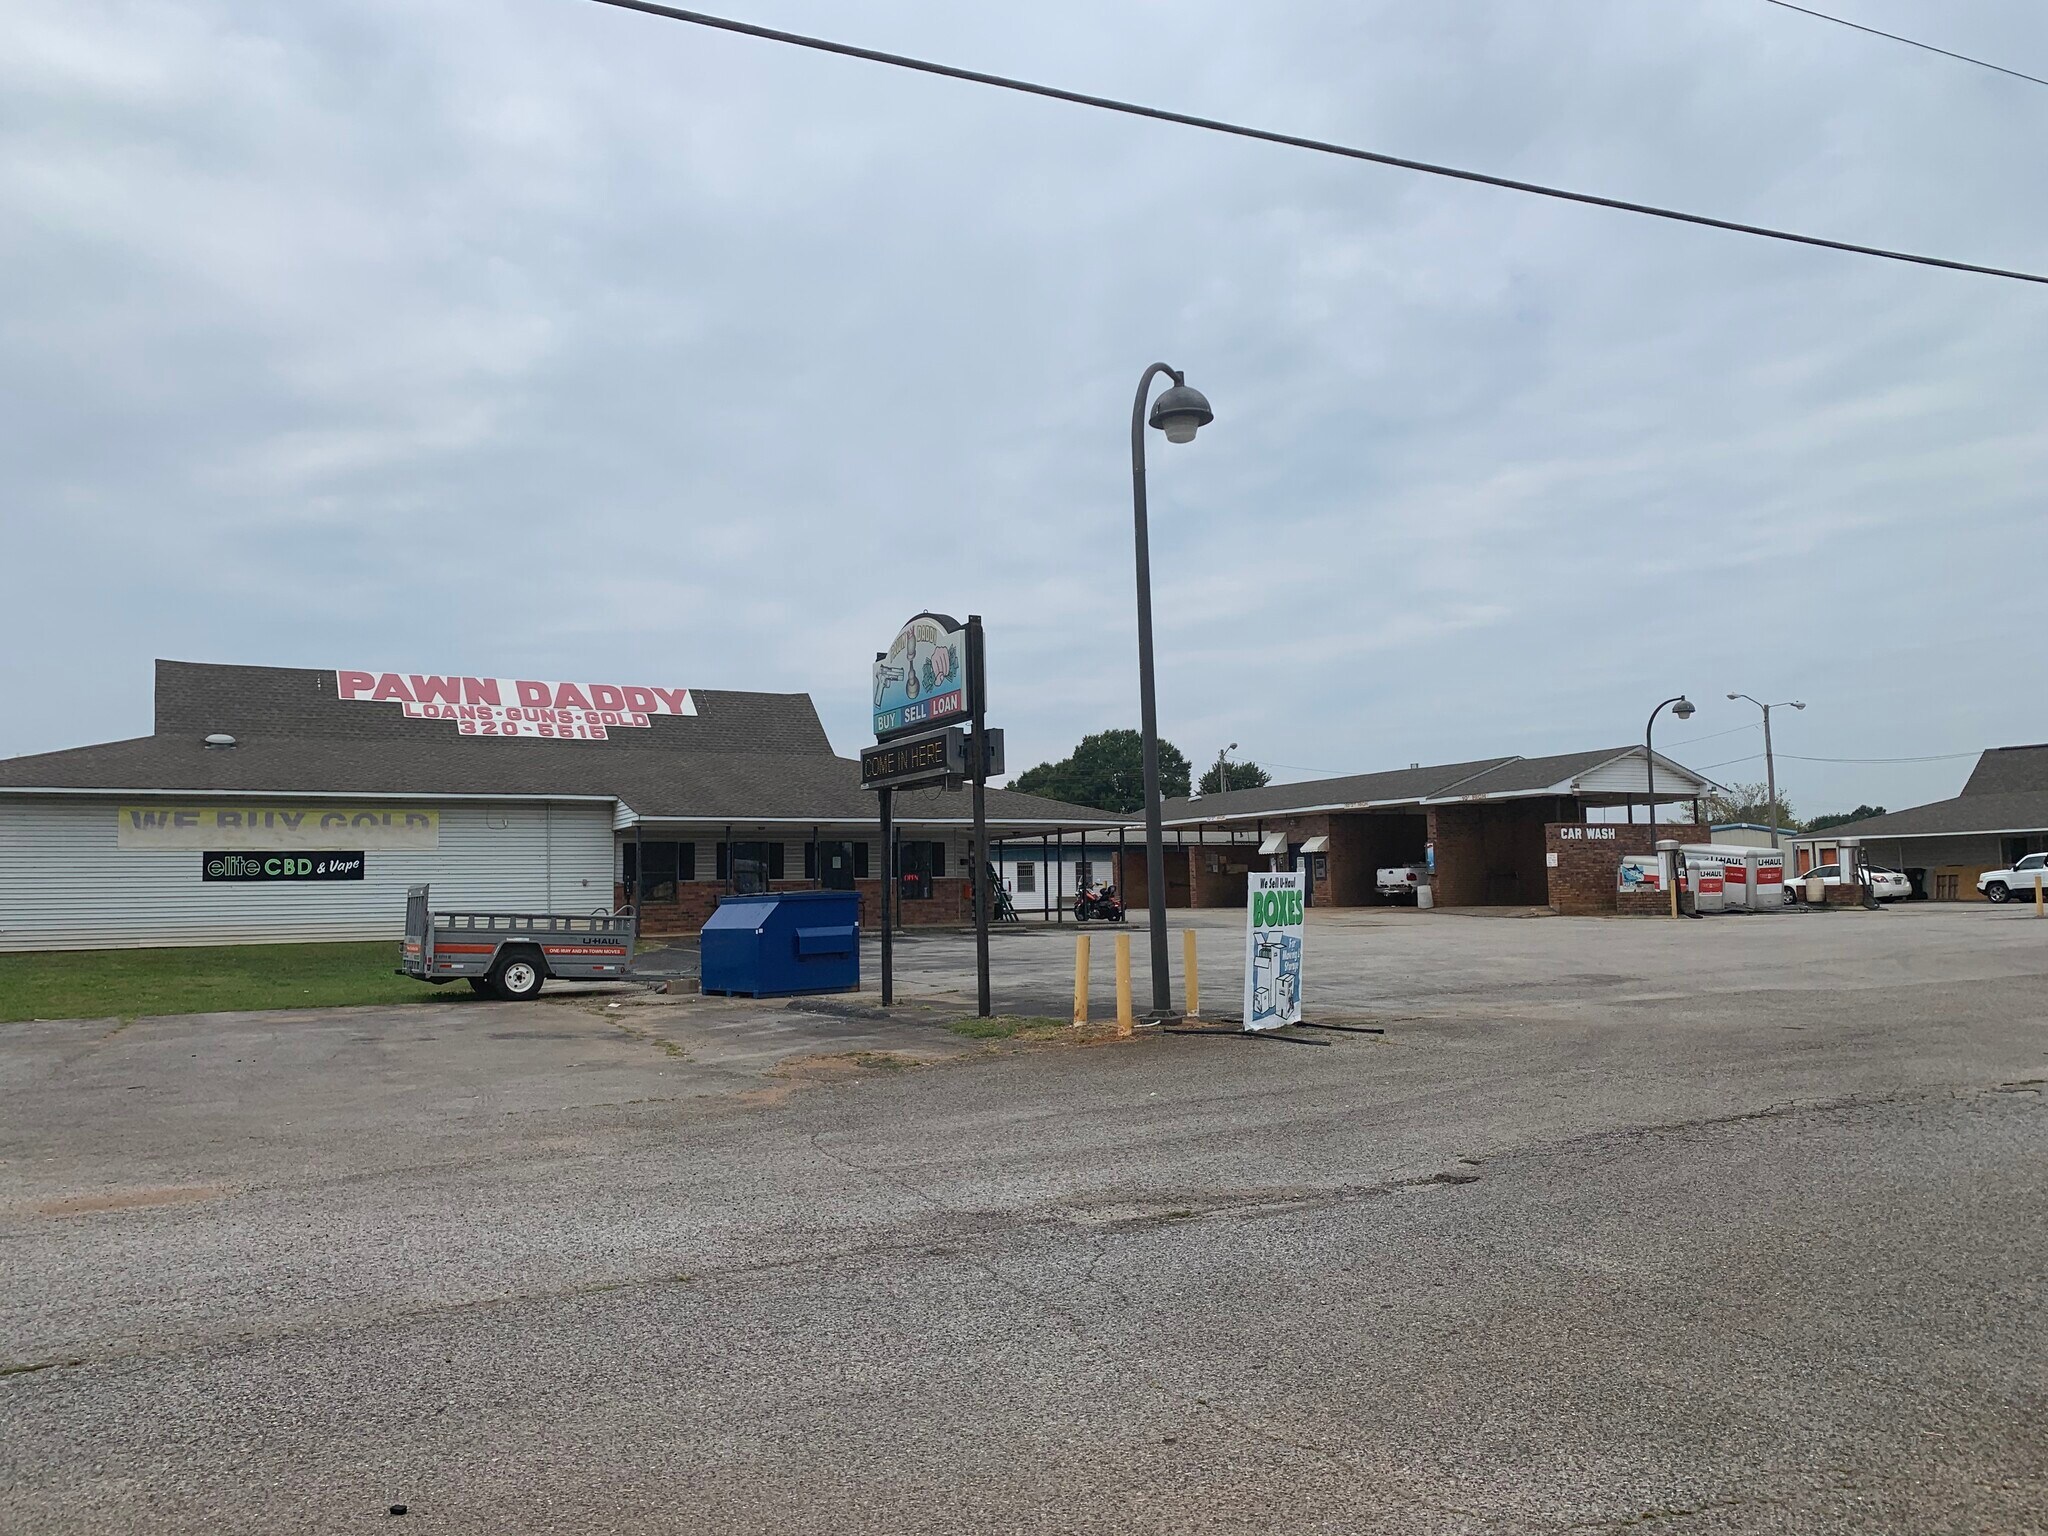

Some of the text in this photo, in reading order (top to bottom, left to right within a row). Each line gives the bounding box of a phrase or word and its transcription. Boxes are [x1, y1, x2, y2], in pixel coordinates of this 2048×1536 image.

[338, 670, 688, 715] PAWN DADDY
[877, 694, 958, 731] BUY SELL LOAN
[864, 741, 943, 777] COME IN HERE
[1560, 827, 1616, 840] CAR WASH
[207, 856, 360, 877] elite CBD & Vape
[903, 873, 919, 881] OPEN
[1260, 876, 1296, 889] We Sell U-Haul
[1253, 889, 1304, 928] BOXES
